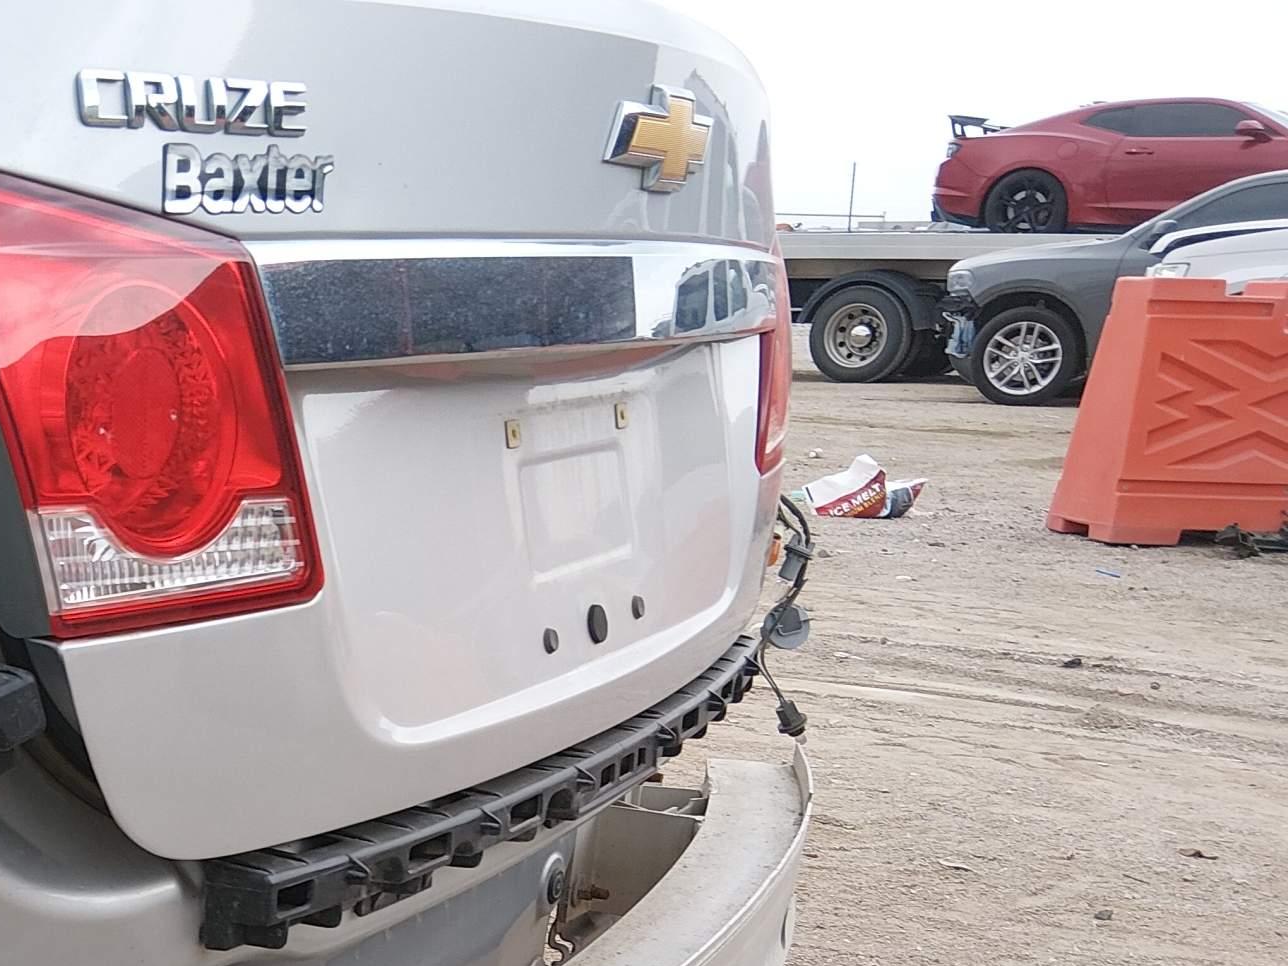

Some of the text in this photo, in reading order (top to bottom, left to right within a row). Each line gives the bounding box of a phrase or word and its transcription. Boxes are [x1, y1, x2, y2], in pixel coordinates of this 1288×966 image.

[76, 68, 307, 137] CRUZE
[162, 143, 335, 214] Baxter
[828, 502, 850, 517] ICE
[851, 484, 881, 506] MELT
